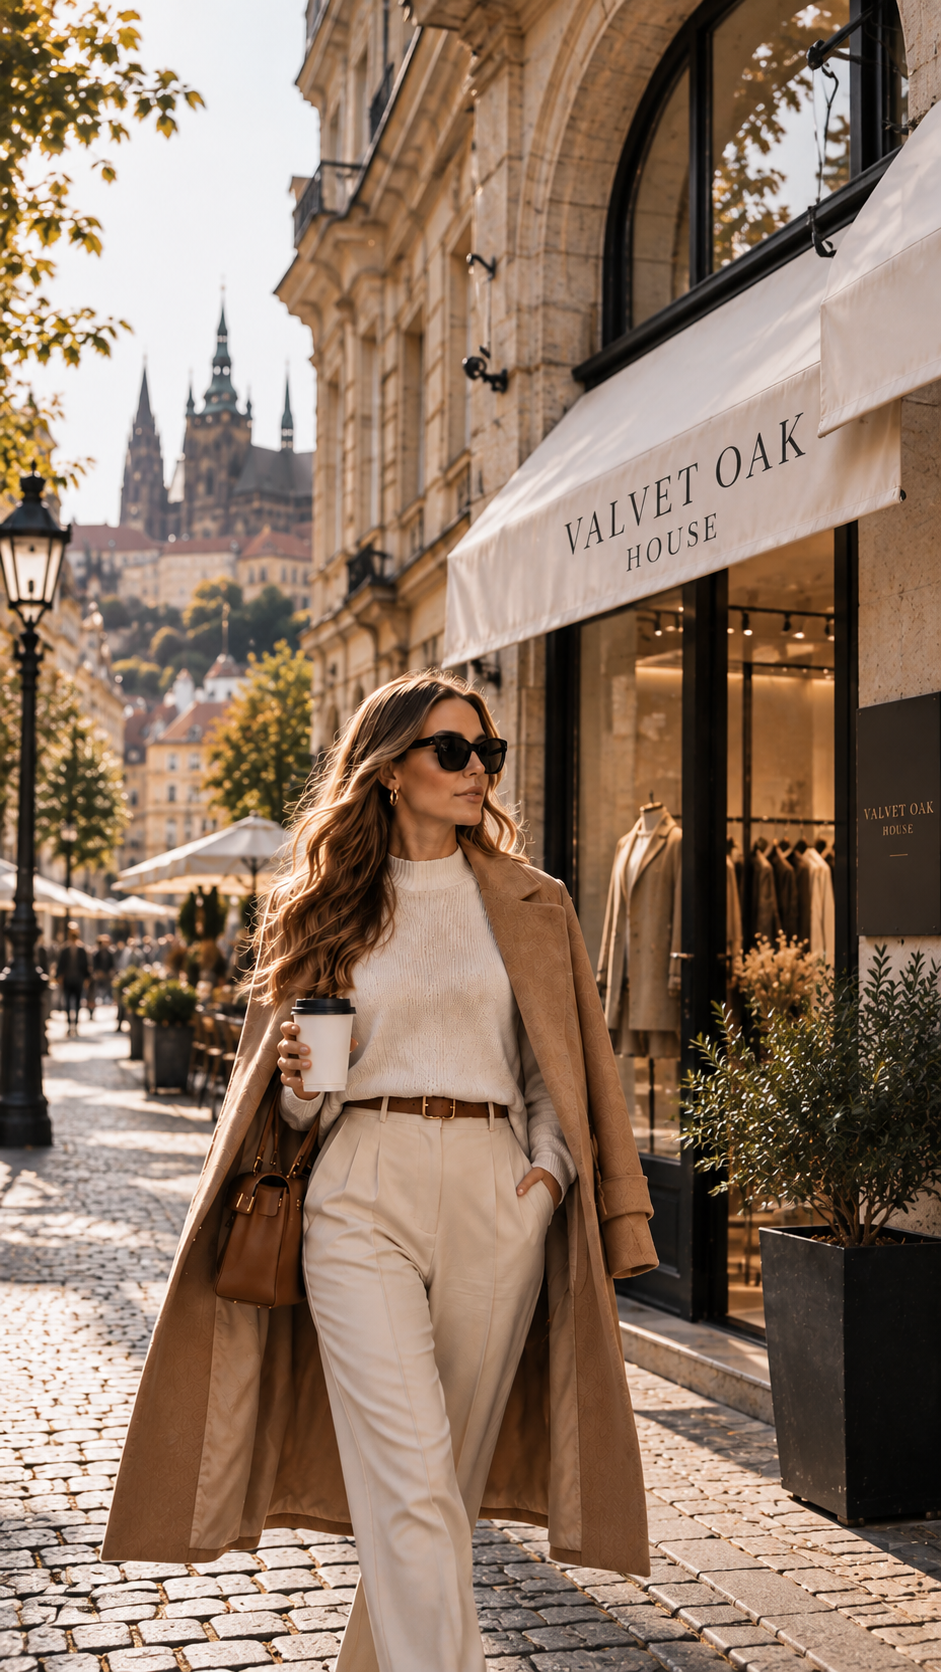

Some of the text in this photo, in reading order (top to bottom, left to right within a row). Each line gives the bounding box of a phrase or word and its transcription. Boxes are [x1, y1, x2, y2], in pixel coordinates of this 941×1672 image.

[564, 412, 806, 555] VALVET OAK
[626, 512, 717, 572] HOUSE
[864, 801, 934, 820] VALVET OAK
[882, 824, 913, 836] HOUSE
